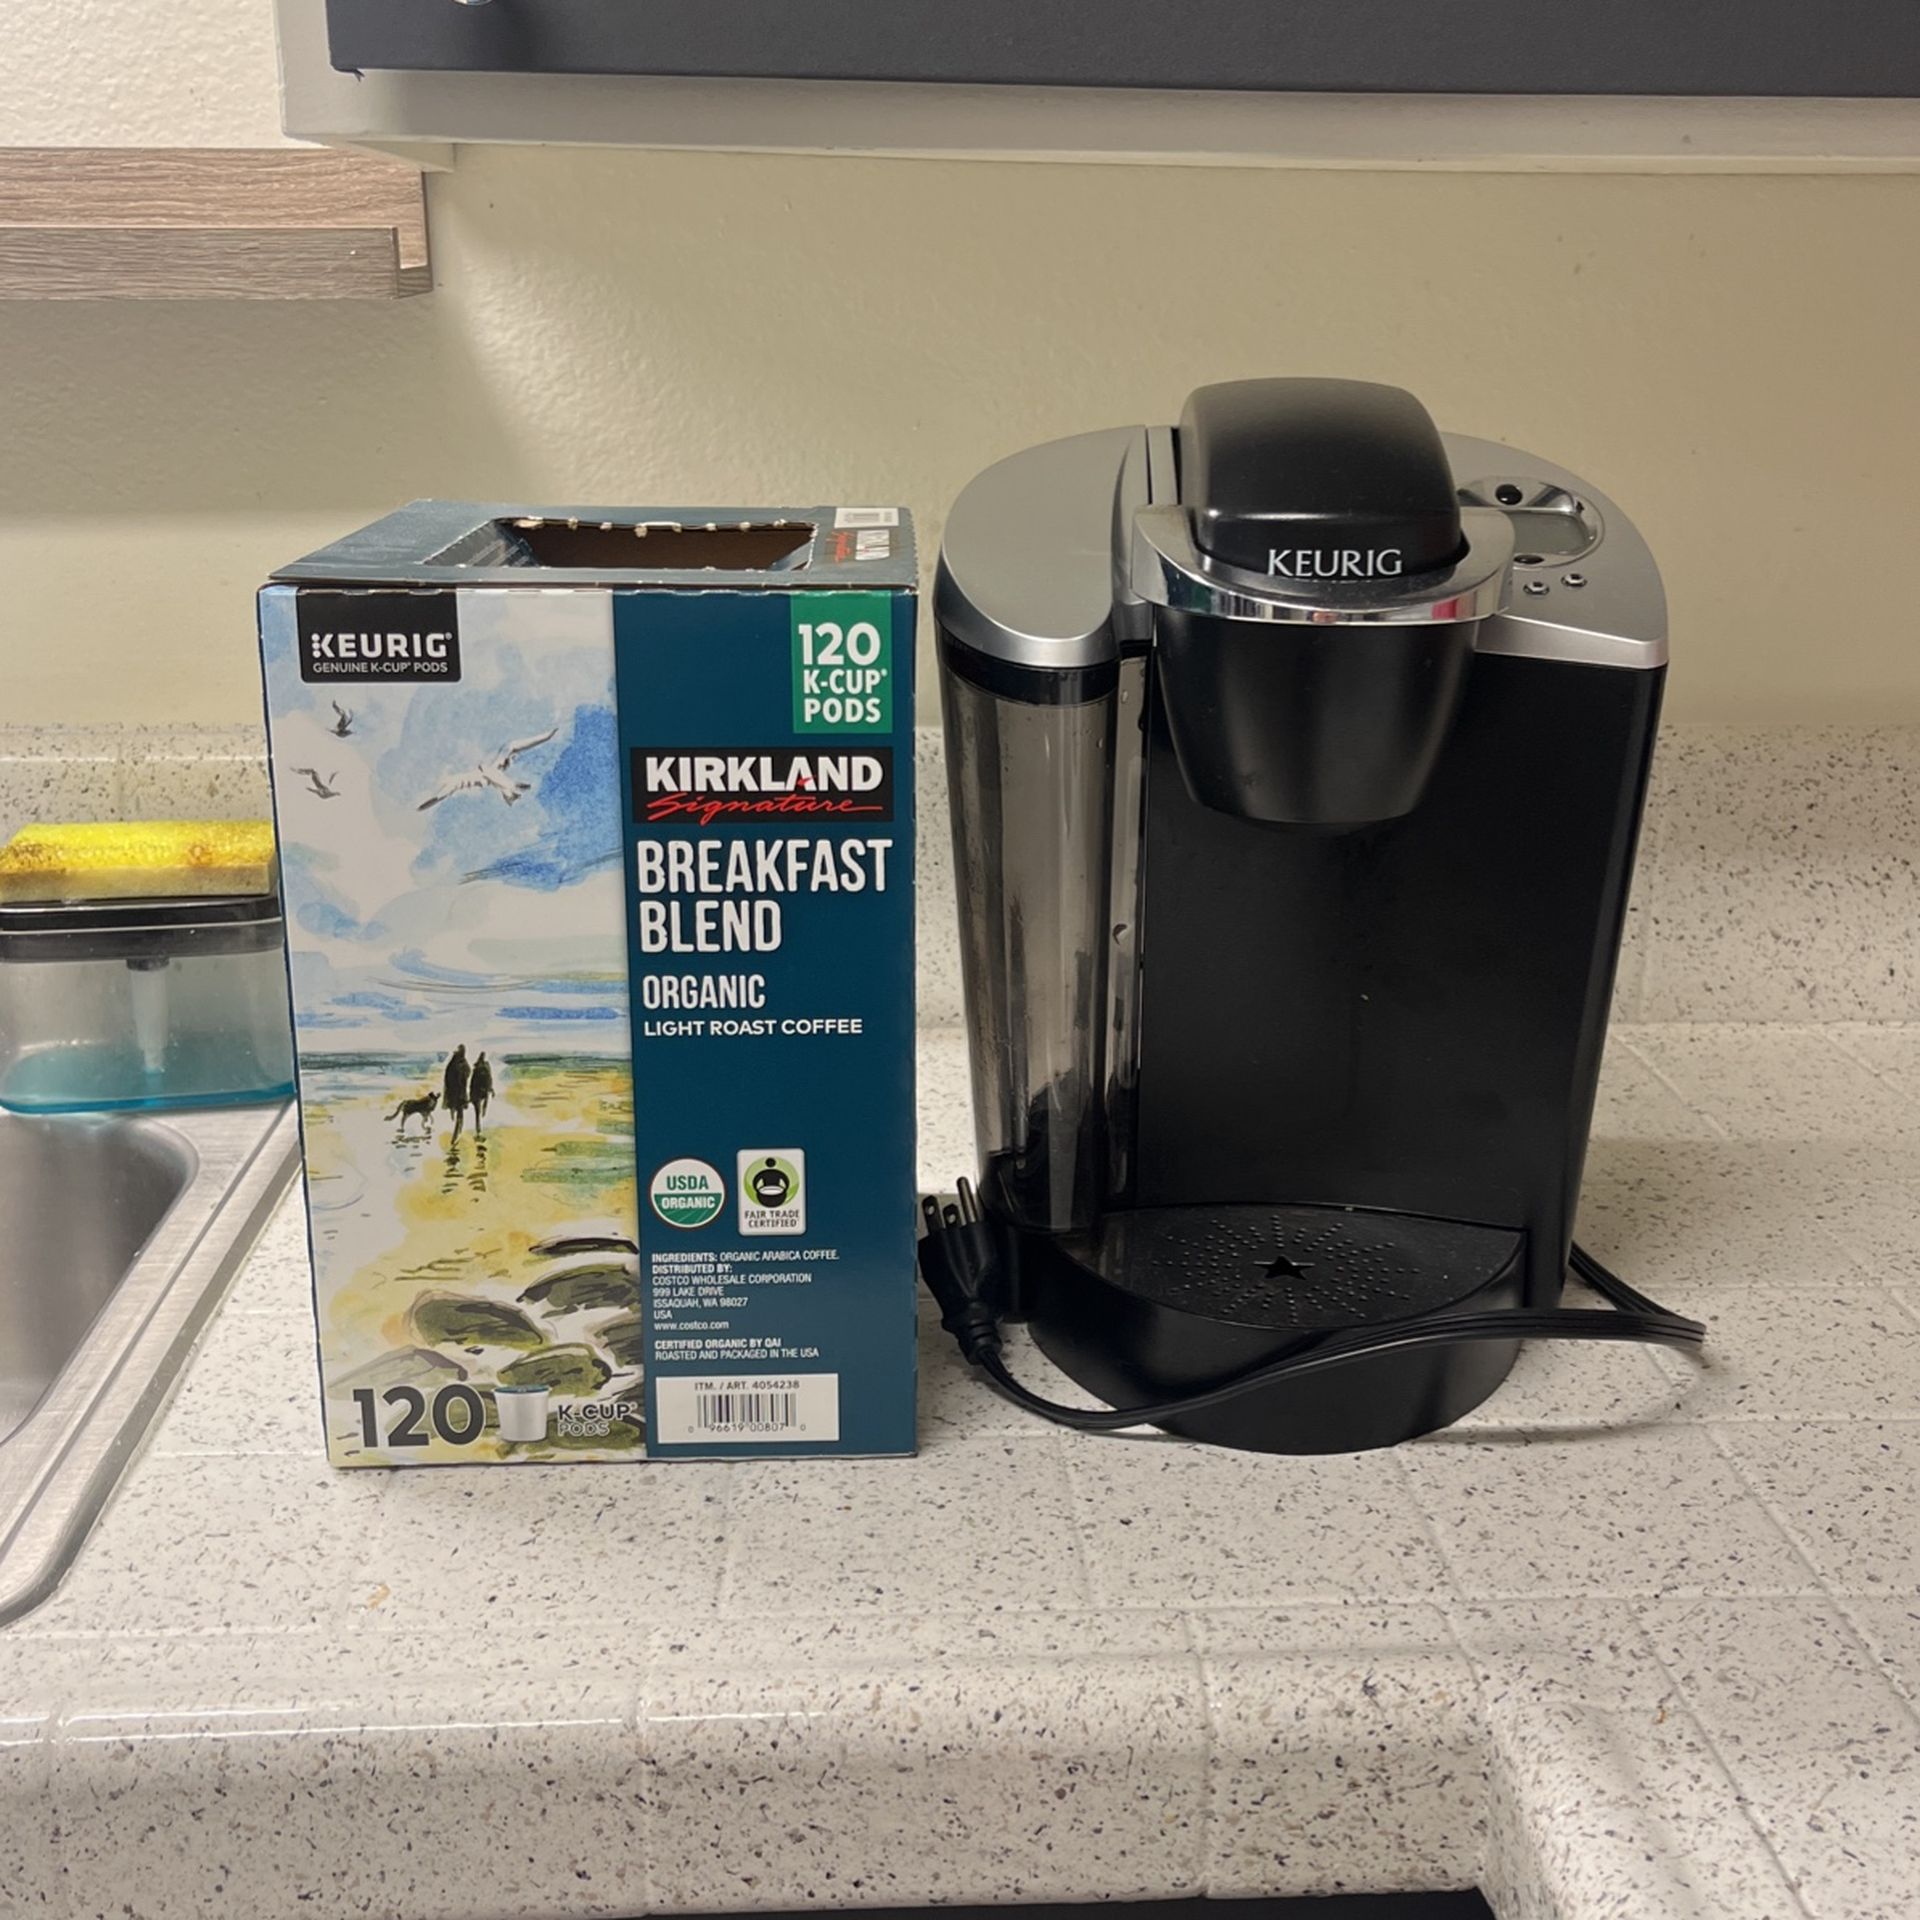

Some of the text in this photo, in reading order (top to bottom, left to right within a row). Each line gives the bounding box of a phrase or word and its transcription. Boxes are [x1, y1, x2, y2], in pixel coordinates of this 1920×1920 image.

[1267, 548, 1402, 578] KEURIG
[312, 633, 447, 658] KEURIG
[798, 622, 881, 666] 120
[313, 662, 368, 673] GENUINE
[413, 662, 448, 673] PODS
[804, 698, 881, 723] PODS
[646, 757, 883, 791] KIRKLAND
[647, 793, 883, 826] Signature
[637, 839, 893, 893] BREAKFAST
[639, 900, 782, 953] BLEND
[643, 974, 766, 1009] ORGANIC
[643, 1019, 863, 1036] LIGHT ROAST COFFEE
[666, 1175, 709, 1191] USDA
[661, 1196, 716, 1210] ORGANIC
[744, 1210, 800, 1219] FAIR TRADE
[748, 1219, 797, 1228] CERTIFIED
[651, 1252, 718, 1263] INGREDIENTS:
[720, 1251, 760, 1262] ORGANIC
[762, 1250, 800, 1261] ARABICA
[652, 1263, 733, 1274] DISTRIBUTED BY:
[652, 1273, 812, 1286] COSTCO WHOLESALE CORPORATION
[652, 1286, 724, 1297] 999 LAKE DRIVE
[653, 1297, 749, 1309] ISSAQUAH, WA 98027
[653, 1310, 673, 1320] USA
[654, 1321, 729, 1331] www.costco.com
[654, 1339, 702, 1350] CERTIFIED
[704, 1338, 747, 1349] ORGANIC
[750, 1338, 763, 1348] BY
[655, 1348, 820, 1361] ROASTED AND PACKAGED IN THE USA
[694, 1381, 716, 1391] ITM.
[726, 1381, 749, 1390] ART.
[752, 1380, 800, 1390] 4054238
[353, 1383, 484, 1448] 120
[558, 1421, 610, 1436] PODS
[687, 1425, 694, 1434] 0
